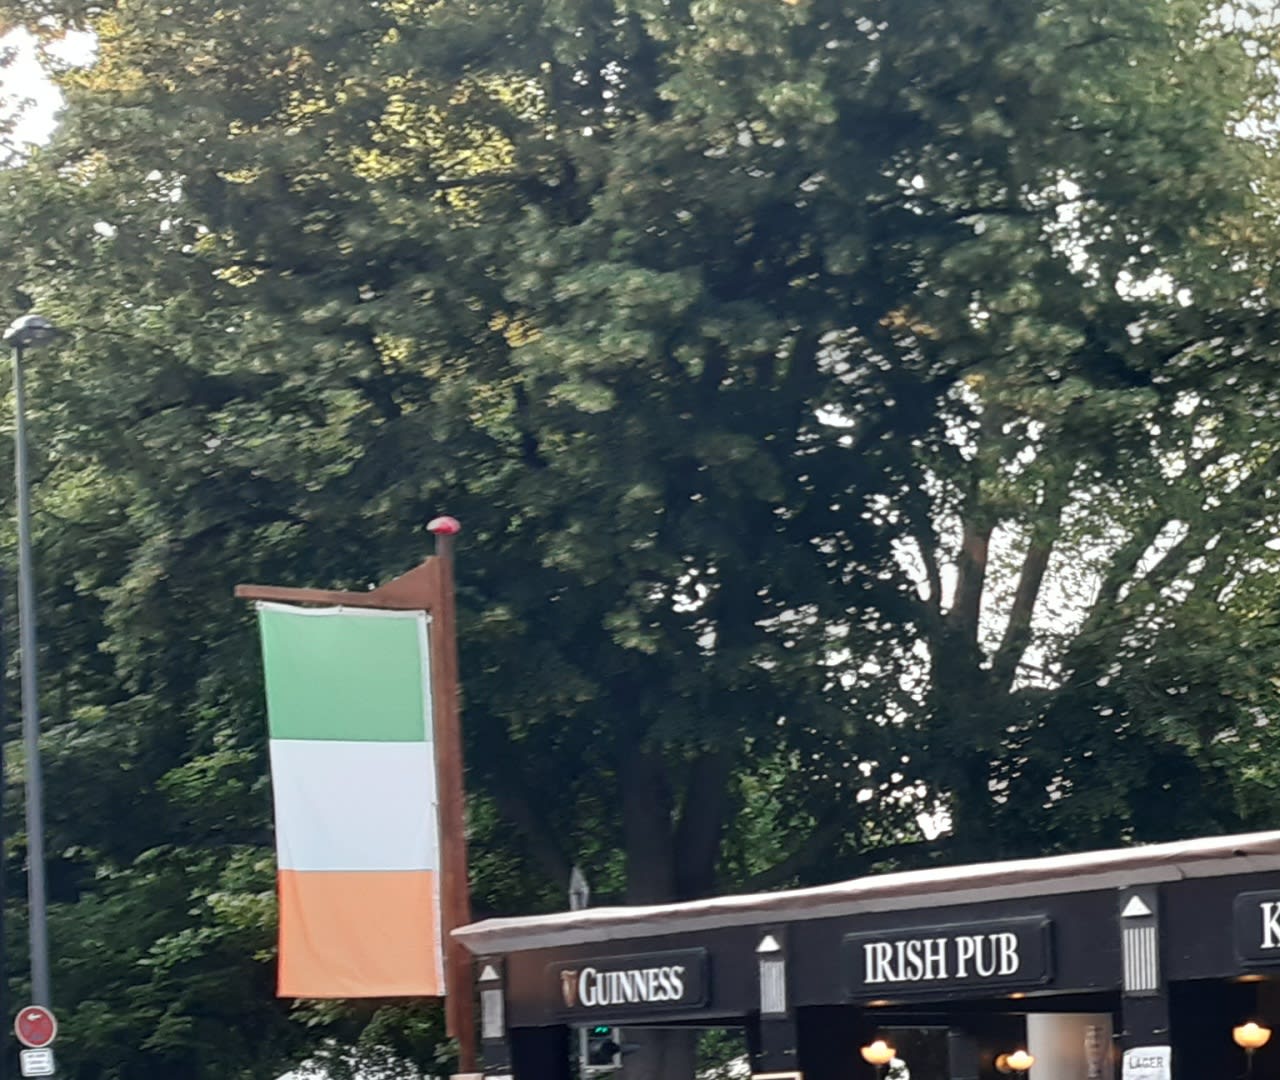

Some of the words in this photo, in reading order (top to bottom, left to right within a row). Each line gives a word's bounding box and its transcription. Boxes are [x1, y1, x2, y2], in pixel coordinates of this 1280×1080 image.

[863, 938, 948, 984] IRISH
[954, 932, 1020, 978] PUB
[578, 965, 685, 1007] GUINNESS
